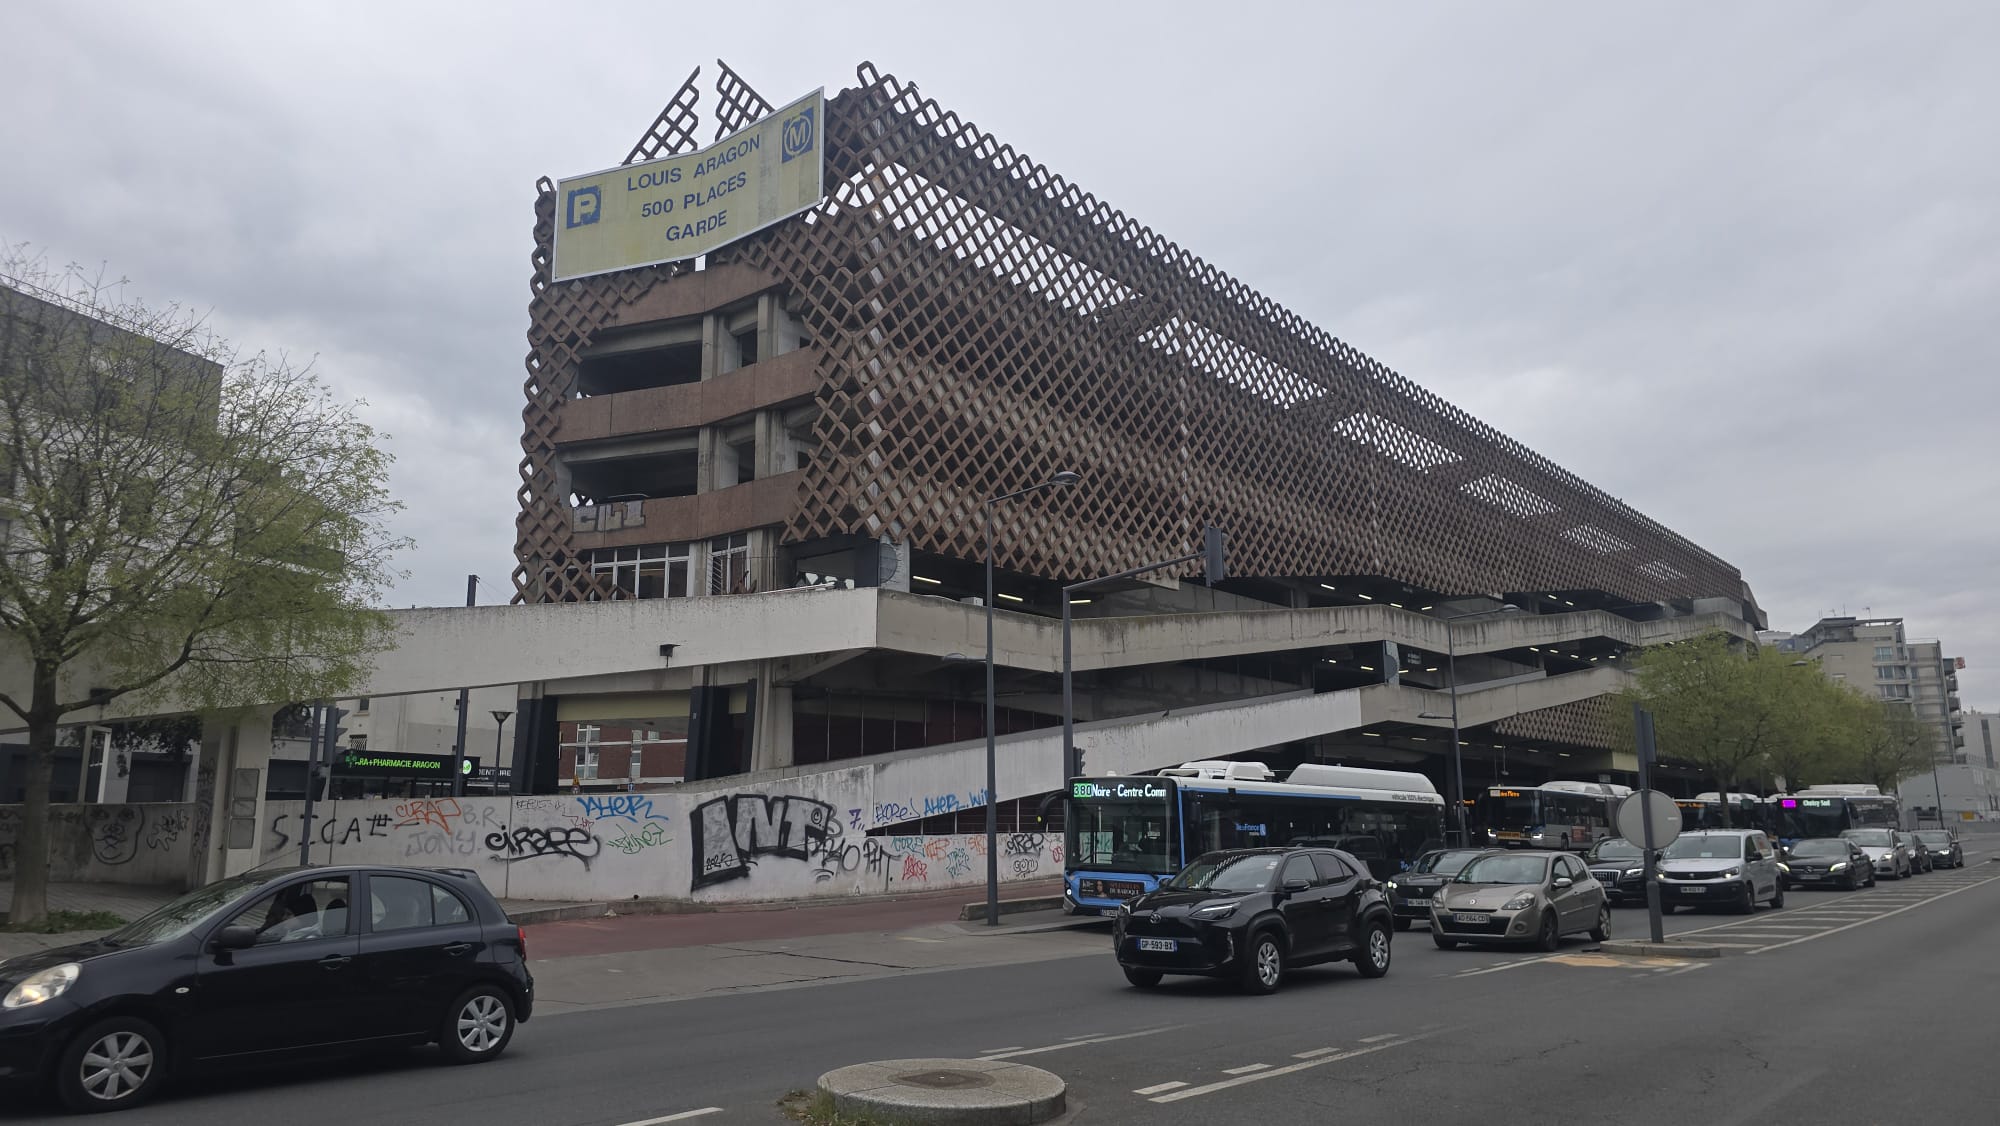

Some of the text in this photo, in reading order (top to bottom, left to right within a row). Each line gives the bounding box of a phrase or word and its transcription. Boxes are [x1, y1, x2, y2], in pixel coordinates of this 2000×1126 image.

[627, 134, 761, 192] LOUIS ARAGON
[641, 172, 747, 218] 500 PLACES
[665, 210, 728, 242] GARDE
[412, 761, 441, 770] ARAGON
[478, 768, 512, 777] ENTIRE
[1074, 784, 1092, 798] 380
[1117, 784, 1144, 798] Centre
[1142, 940, 1173, 950] GP-593-BX
